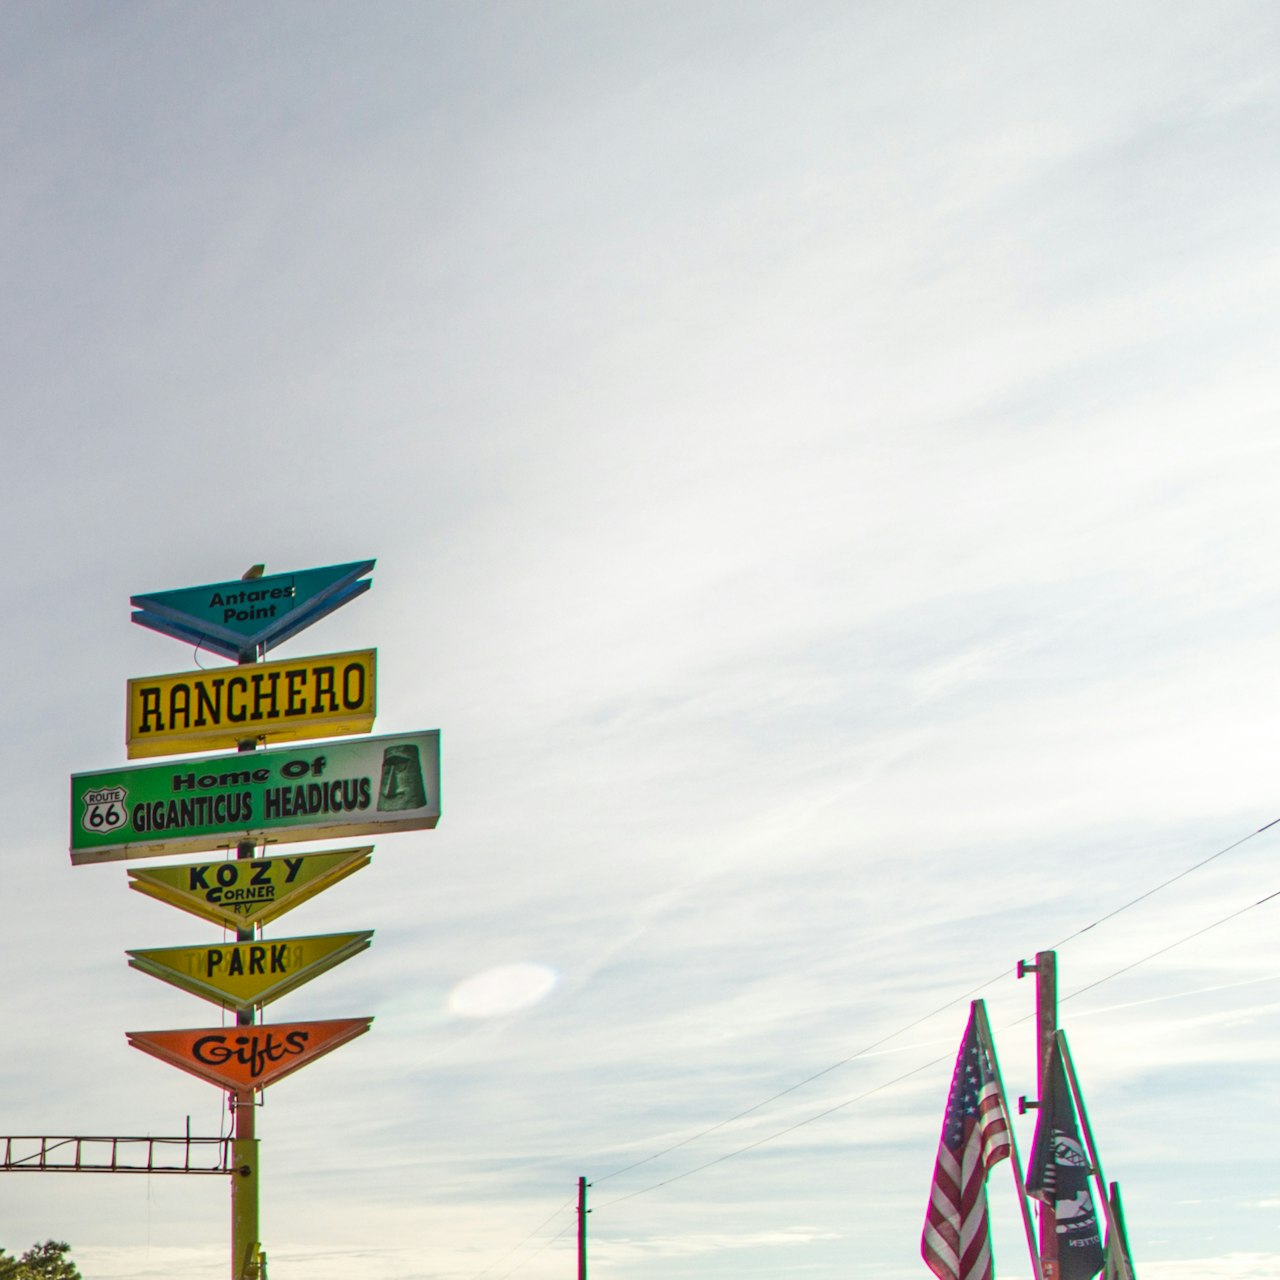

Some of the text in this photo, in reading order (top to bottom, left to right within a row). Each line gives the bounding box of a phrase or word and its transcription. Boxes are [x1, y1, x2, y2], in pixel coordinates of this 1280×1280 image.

[209, 586, 293, 608] Antares
[224, 604, 277, 623] Point
[139, 662, 365, 733] RANCHERO
[172, 756, 326, 791] Home Of
[89, 791, 121, 803] ROUTE
[132, 777, 371, 833] GIGANTICUS HEADICUS
[90, 804, 120, 827] 66
[190, 858, 304, 890] KOZY
[206, 885, 275, 902] CORNER
[234, 904, 252, 914] RV
[207, 944, 287, 977] PARK
[192, 1031, 309, 1077] Gifts
